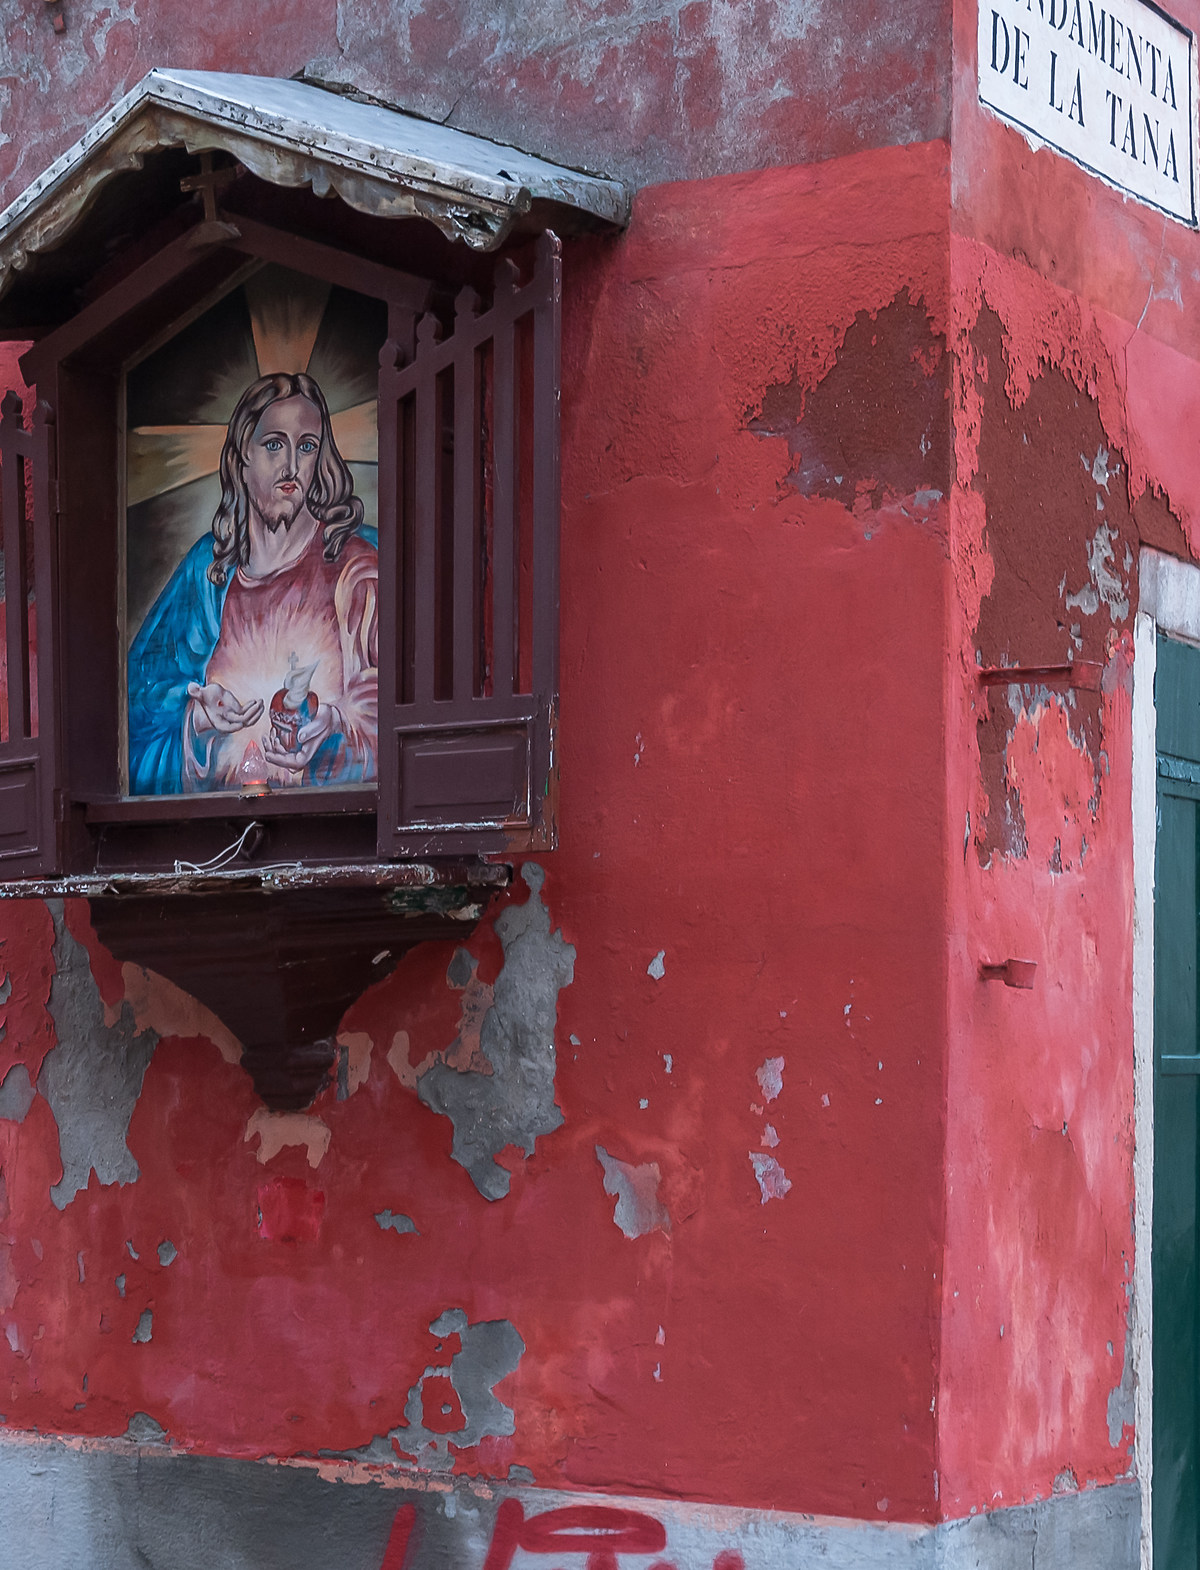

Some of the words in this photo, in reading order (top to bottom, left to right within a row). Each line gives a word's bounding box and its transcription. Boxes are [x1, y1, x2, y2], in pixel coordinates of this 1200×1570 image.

[990, 9, 1030, 91] DE
[1049, 50, 1085, 128] LA
[1105, 89, 1179, 184] TANA
